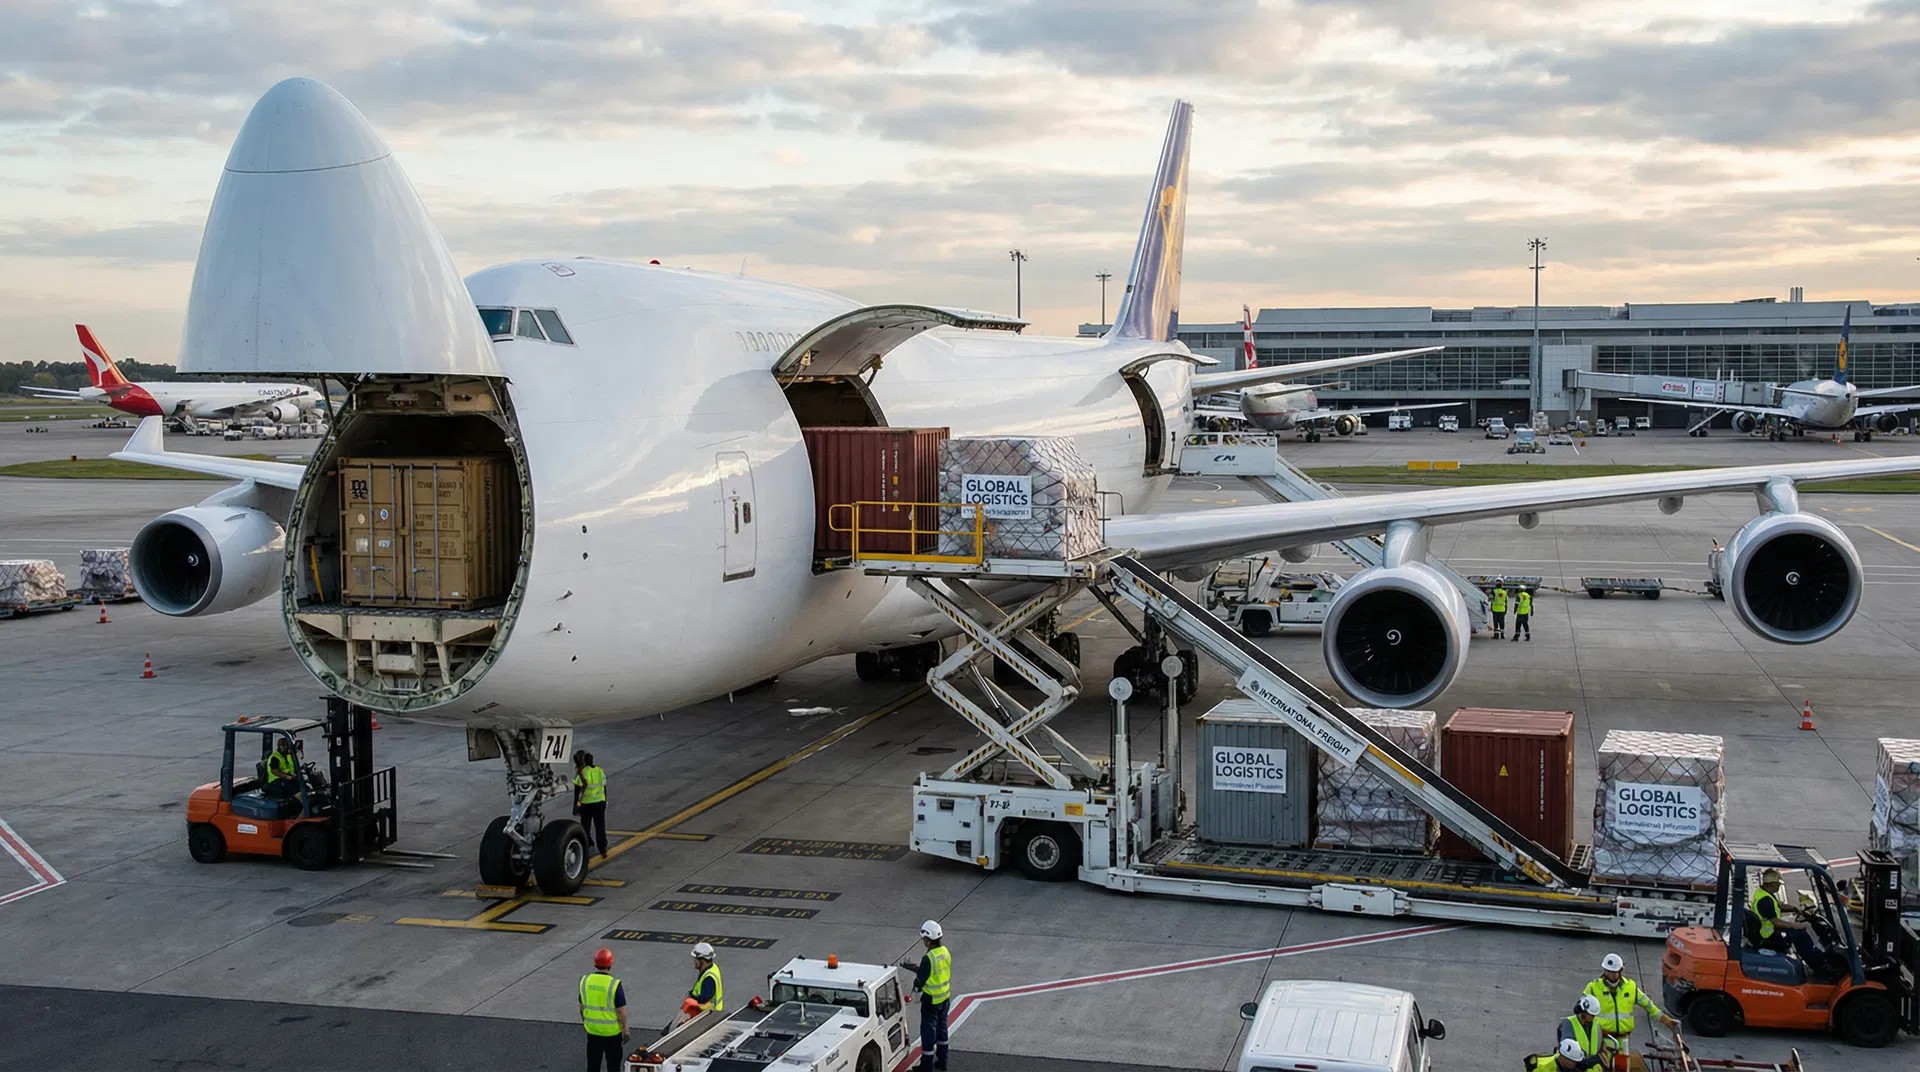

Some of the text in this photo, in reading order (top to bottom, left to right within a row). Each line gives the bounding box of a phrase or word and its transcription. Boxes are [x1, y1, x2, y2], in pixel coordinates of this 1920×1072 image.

[966, 479, 1023, 493] GLOBAL
[965, 493, 1028, 505] LOGISTICS
[1259, 688, 1316, 733] INTERNATIONAL
[1215, 752, 1274, 766] GLOBAL
[1215, 765, 1283, 779] LOGISTICS
[1619, 788, 1686, 804] GLOBAL
[1619, 803, 1698, 819] LOGISTICS
